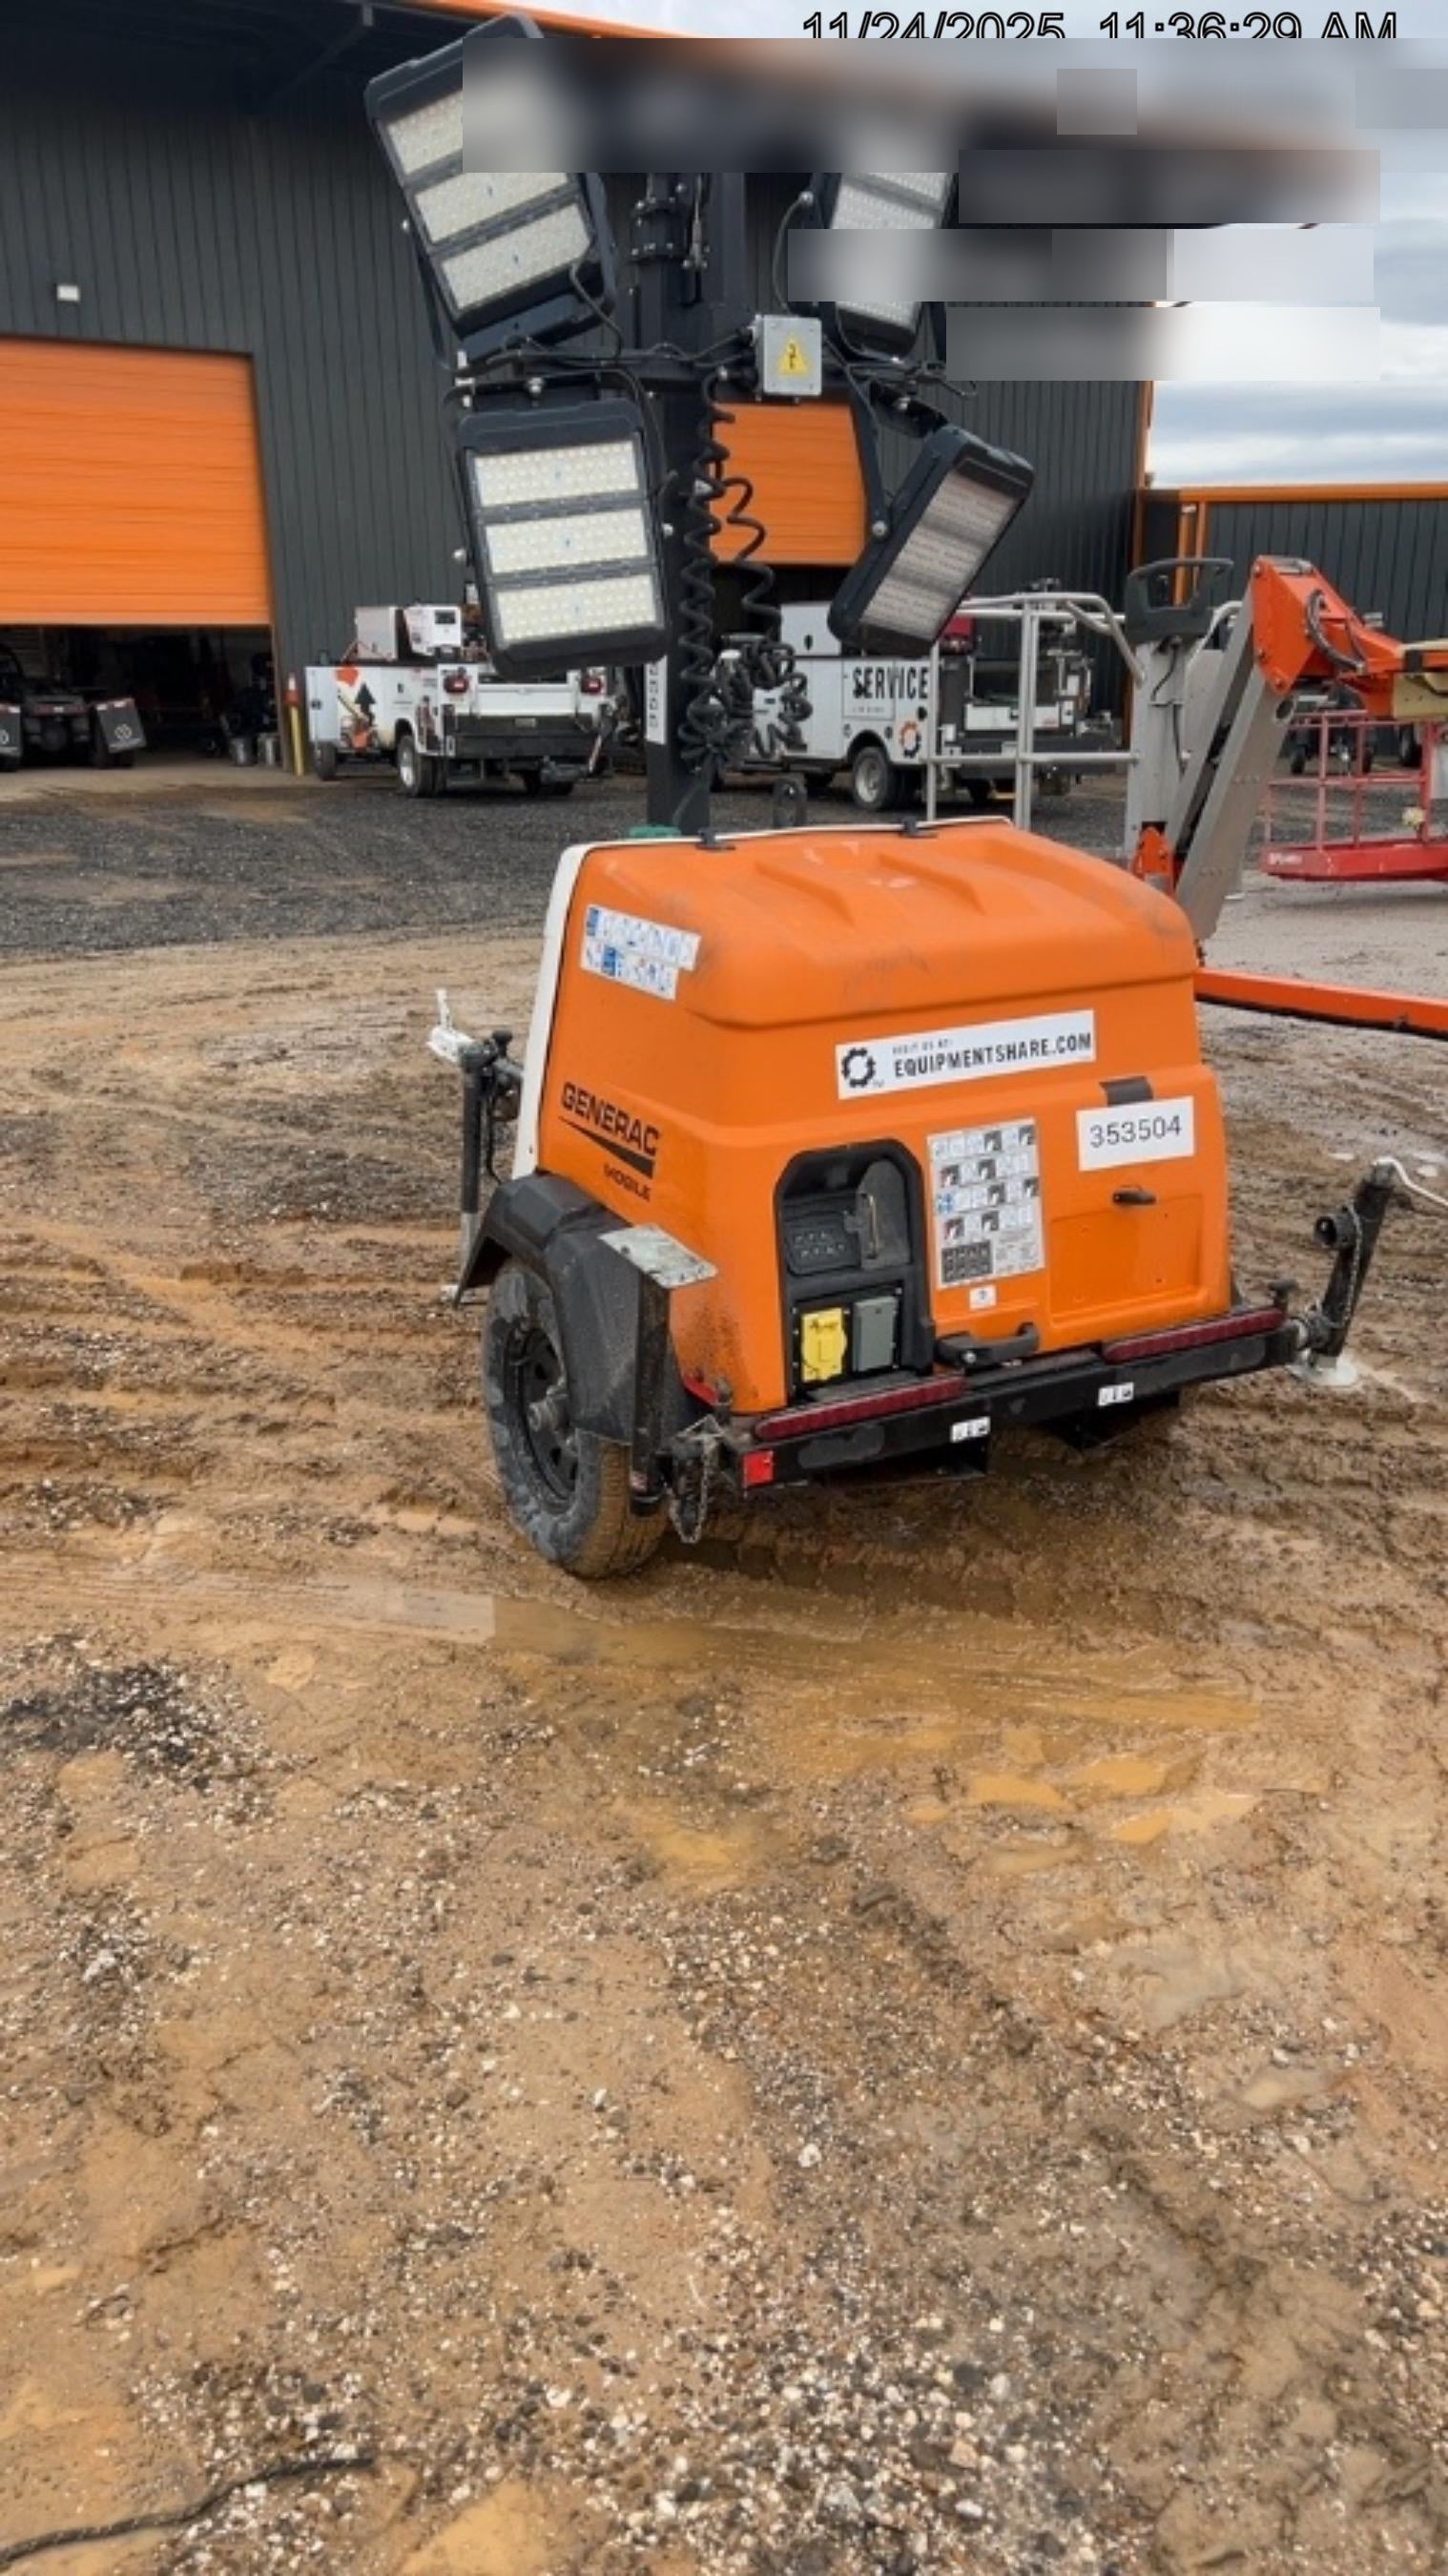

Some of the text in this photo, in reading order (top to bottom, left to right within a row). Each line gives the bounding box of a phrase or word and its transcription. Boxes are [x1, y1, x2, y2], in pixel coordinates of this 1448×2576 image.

[853, 667, 928, 699] SERVICE
[895, 1033, 1091, 1078] EQUIPMENTSHARE.COM
[562, 1081, 659, 1156] GENERAC
[1090, 1114, 1181, 1148] 353504
